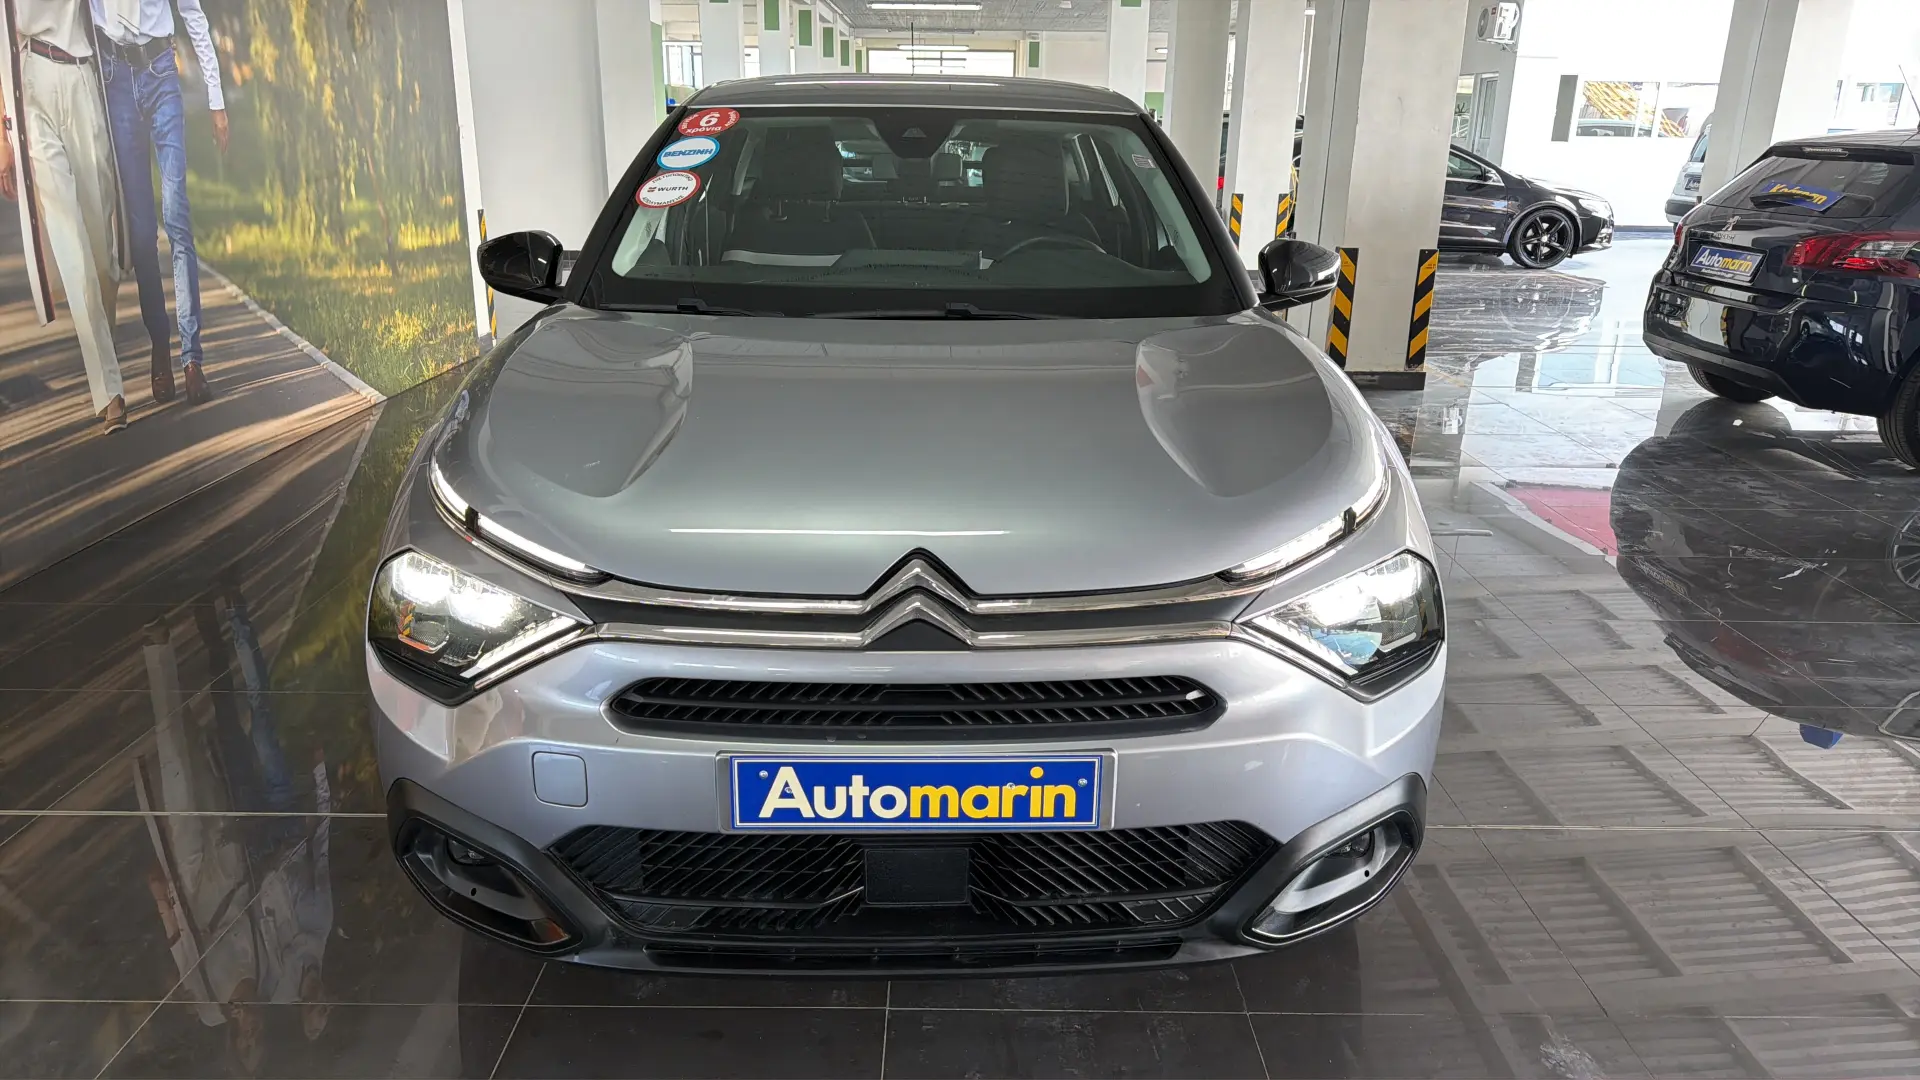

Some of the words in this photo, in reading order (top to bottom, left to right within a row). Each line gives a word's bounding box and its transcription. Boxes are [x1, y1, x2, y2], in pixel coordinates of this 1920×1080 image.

[700, 113, 720, 127] 6
[1696, 249, 1752, 272] Automarin
[758, 766, 1076, 819] Automarin
